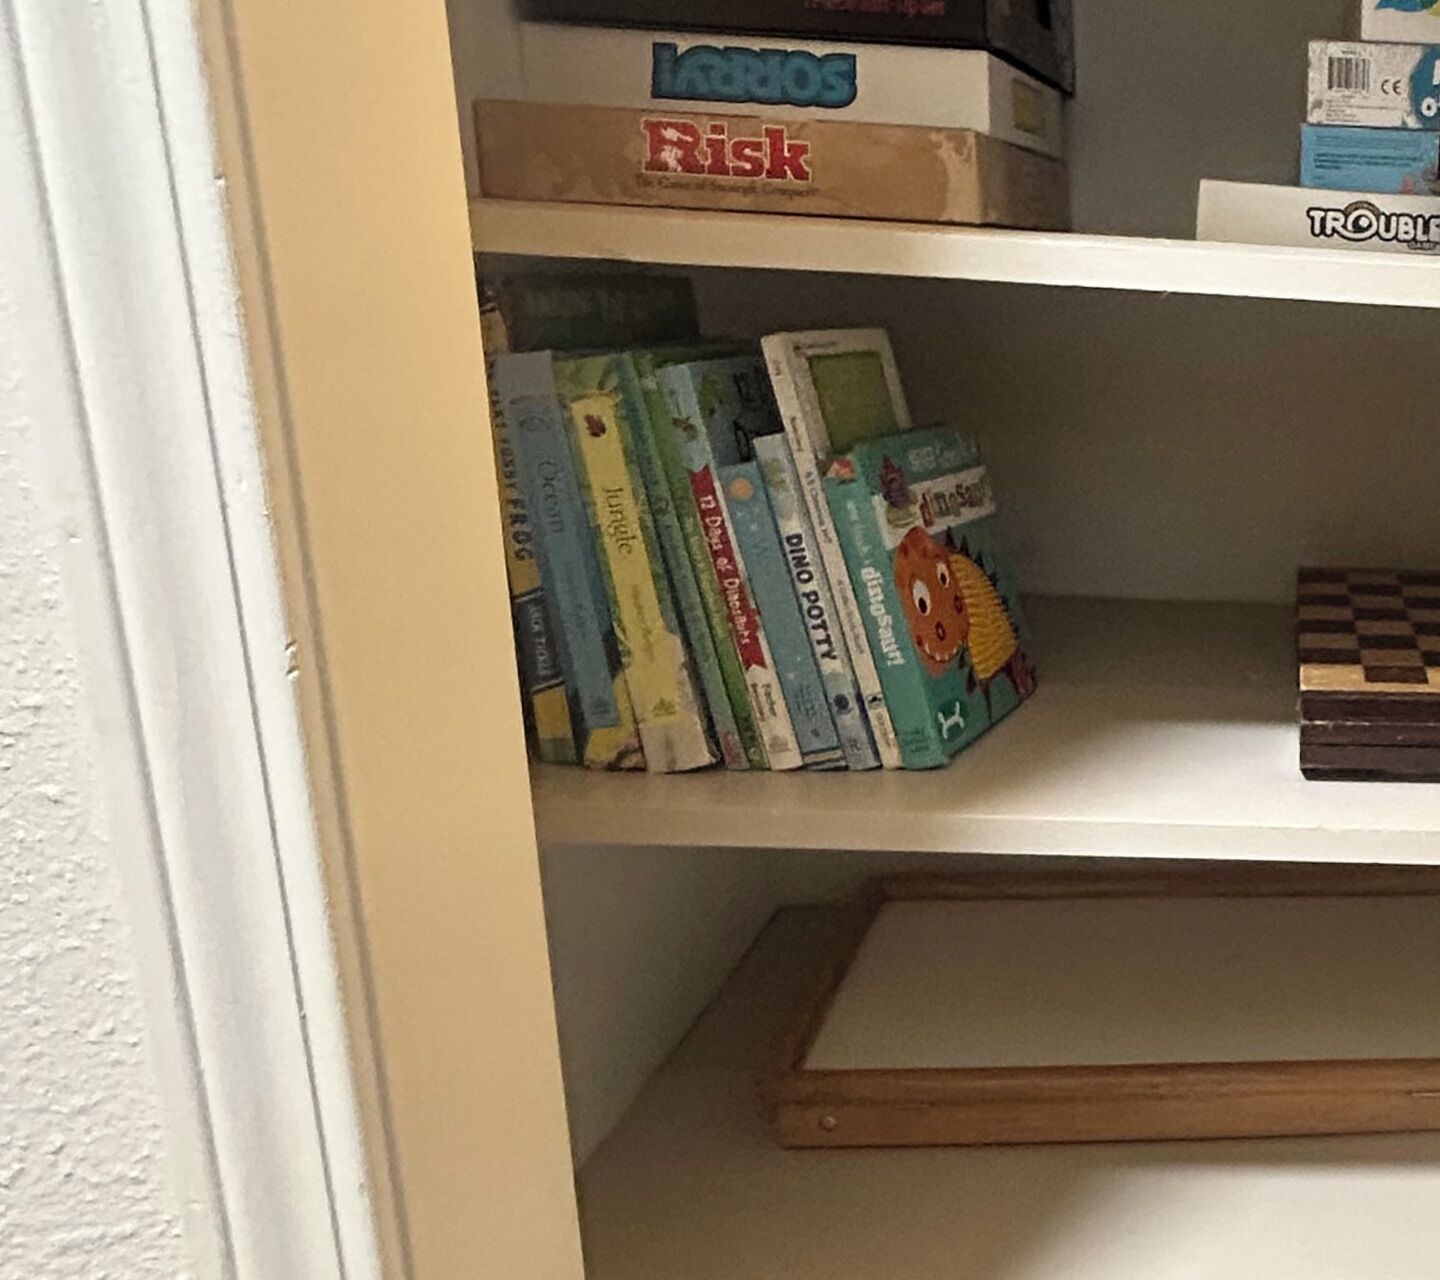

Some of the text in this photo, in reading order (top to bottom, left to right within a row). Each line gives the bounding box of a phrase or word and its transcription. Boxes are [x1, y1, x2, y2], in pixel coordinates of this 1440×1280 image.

[641, 117, 812, 183] Risk
[785, 532, 814, 585] DINO
[801, 590, 838, 661] POTTY
